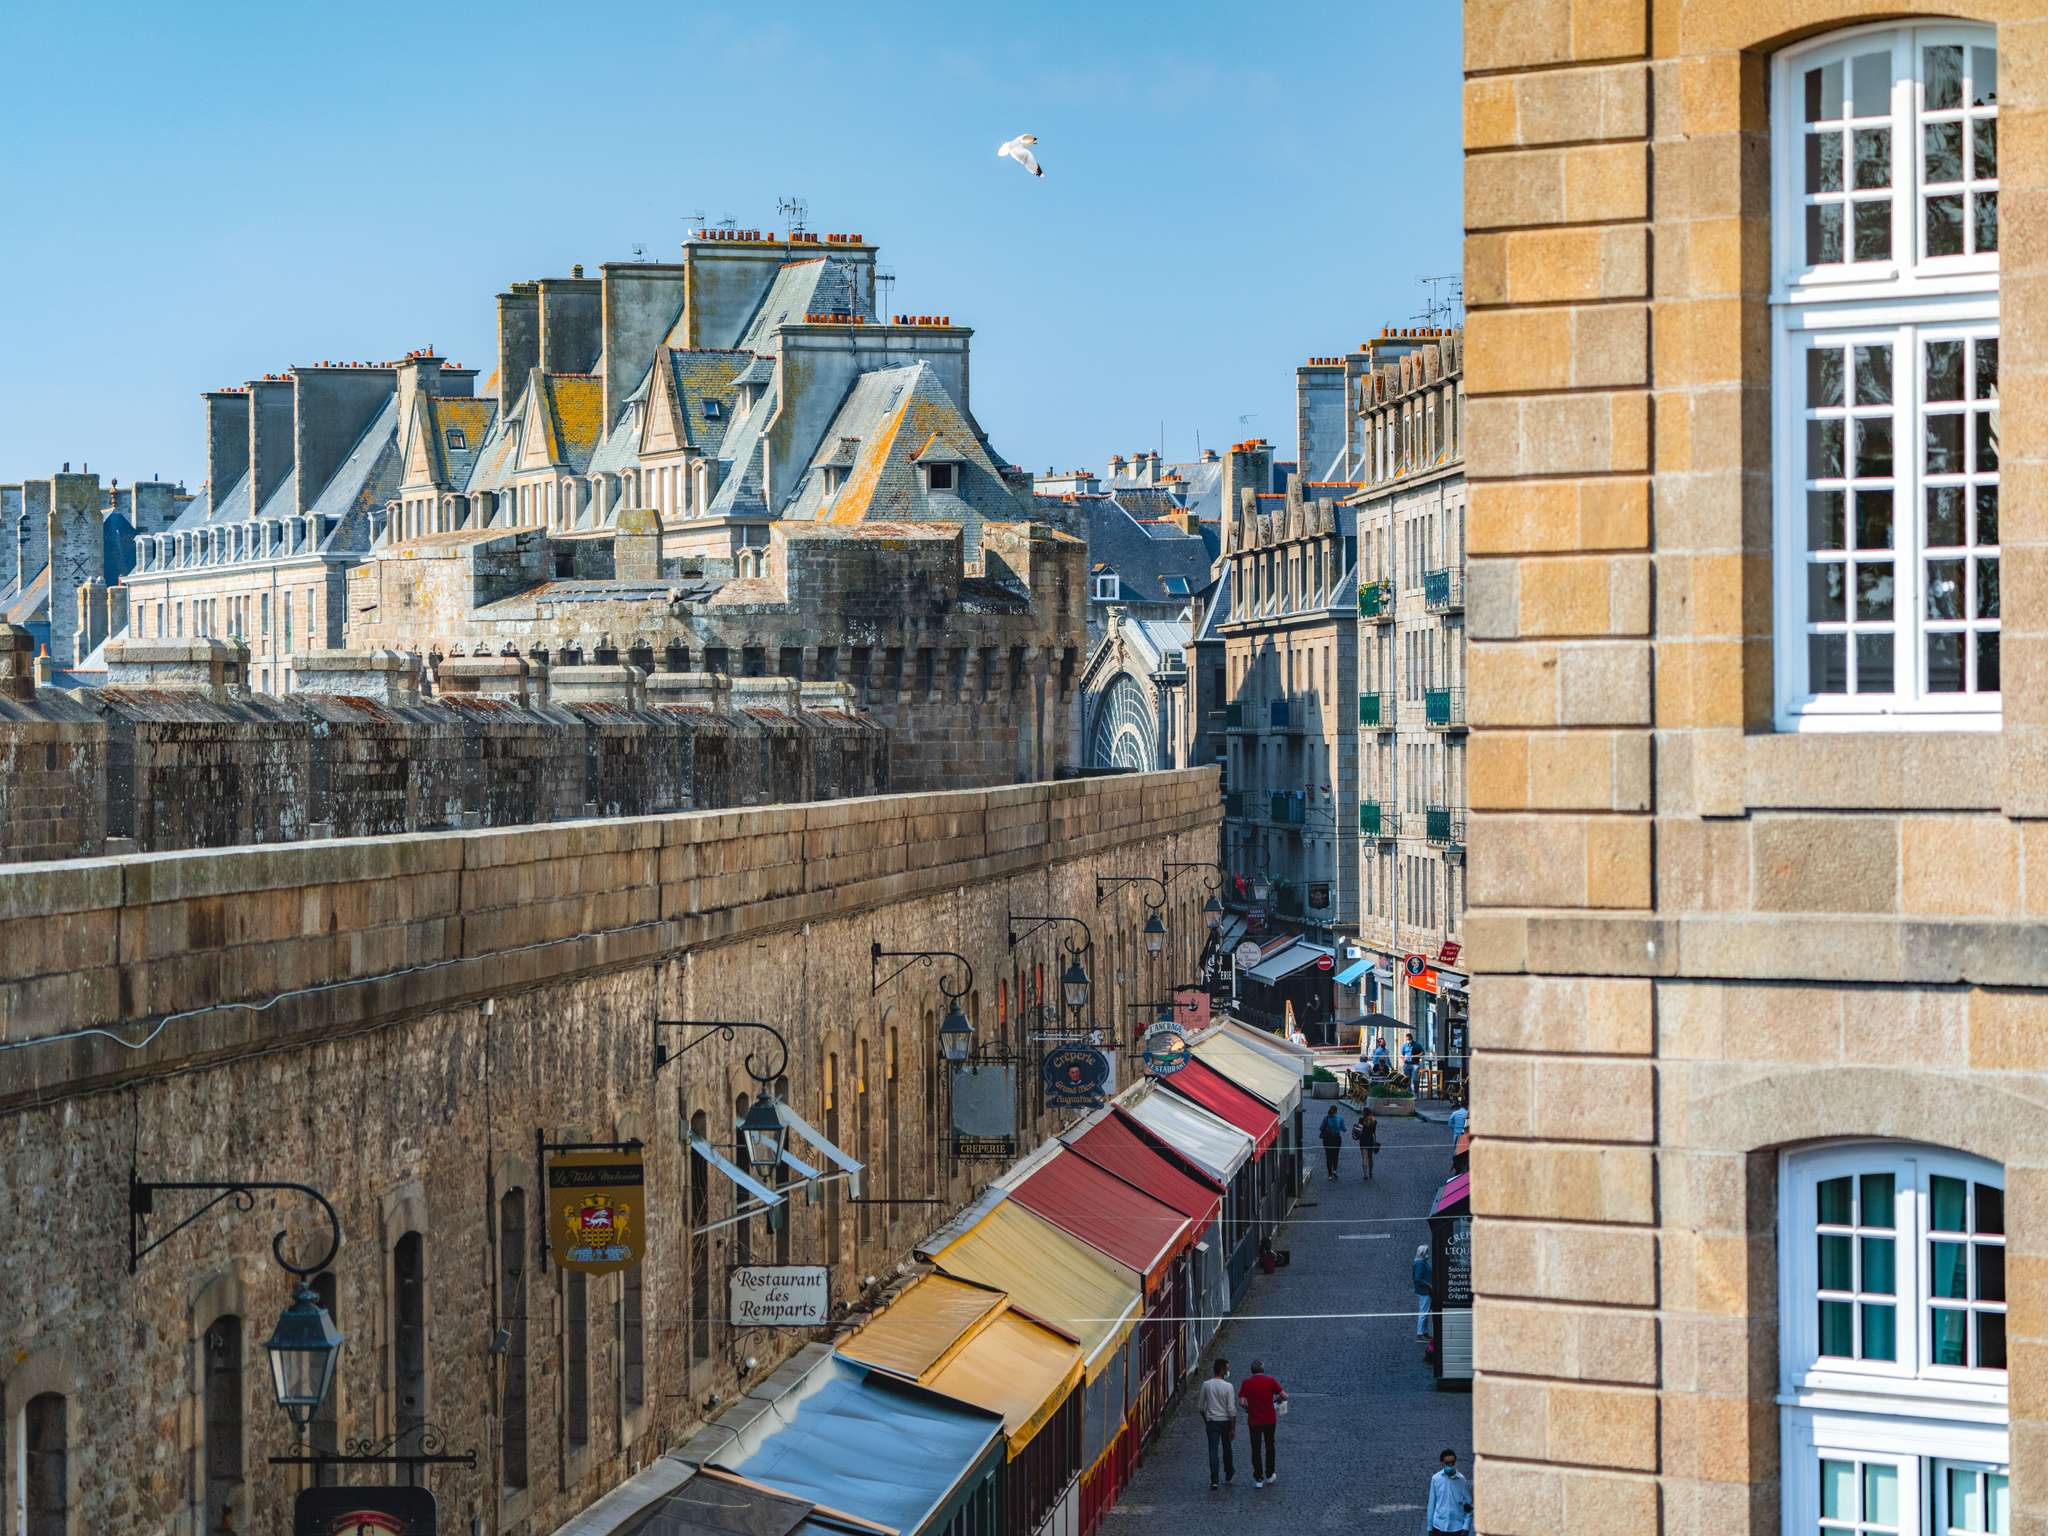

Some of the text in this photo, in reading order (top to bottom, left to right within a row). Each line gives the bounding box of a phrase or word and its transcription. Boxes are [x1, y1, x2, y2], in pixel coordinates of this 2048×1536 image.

[1149, 1022, 1184, 1034] L'ANCRAGE
[1447, 1231, 1472, 1246] CREP
[1445, 1245, 1472, 1257] L'ÉQU
[737, 1271, 822, 1291] Restaurant
[765, 1287, 790, 1302] des
[739, 1300, 817, 1321] Remparts
